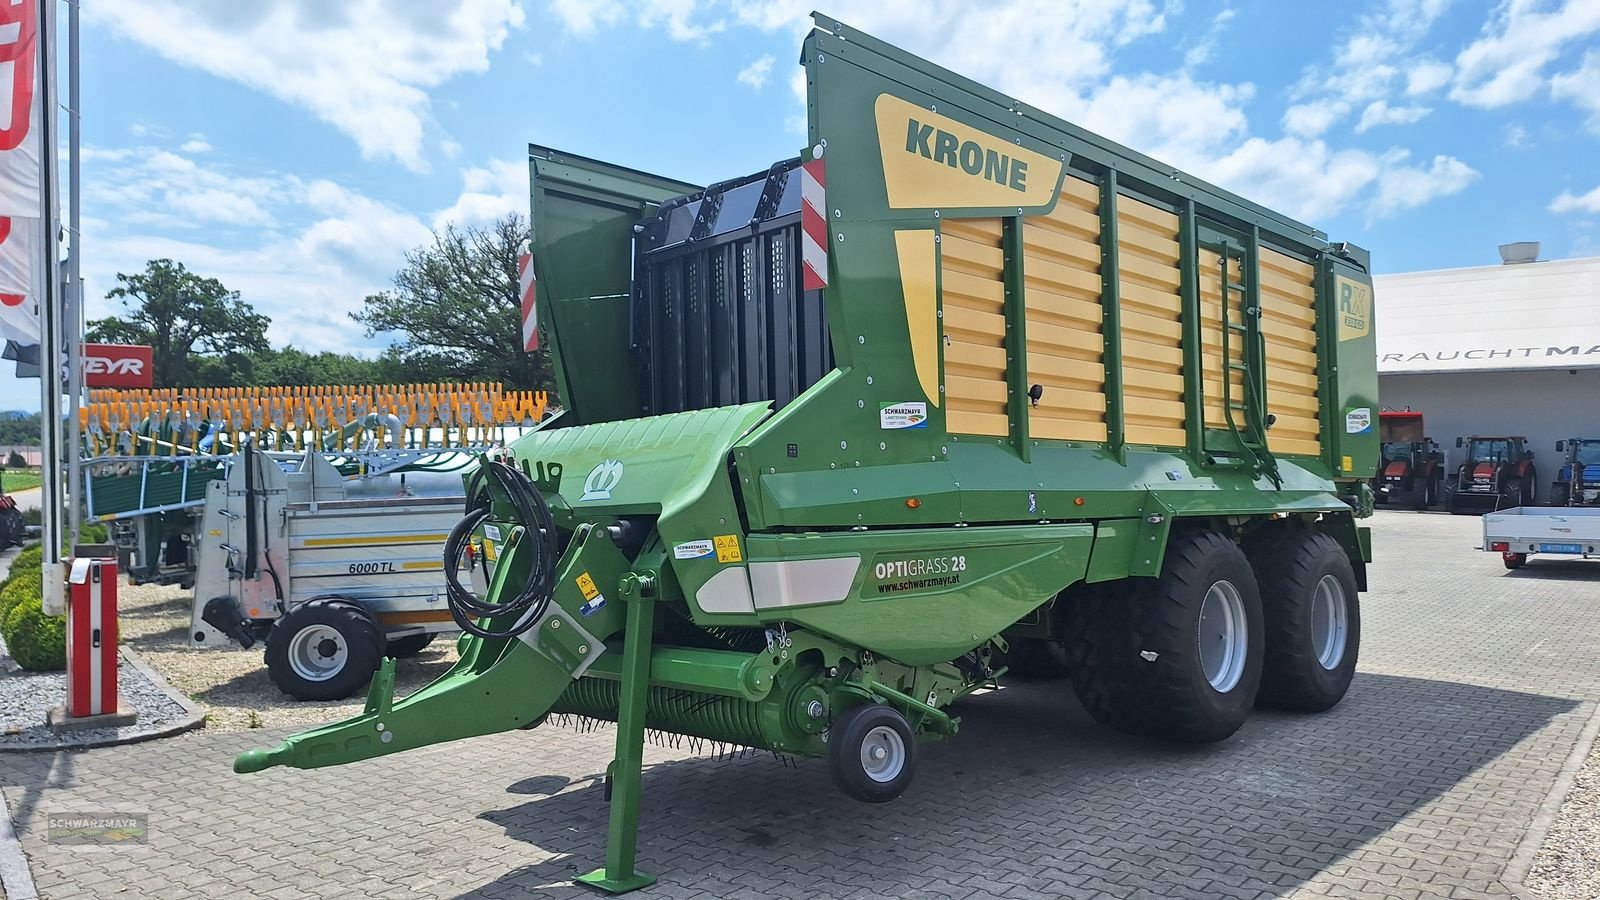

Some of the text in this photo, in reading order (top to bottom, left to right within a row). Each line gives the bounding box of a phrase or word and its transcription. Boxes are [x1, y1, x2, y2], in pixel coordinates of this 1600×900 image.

[906, 118, 1028, 193] KRONE
[1340, 282, 1366, 318] RX
[875, 555, 967, 579] OPTIGRASS 28
[878, 573, 960, 593] www.schwarzmayr.at
